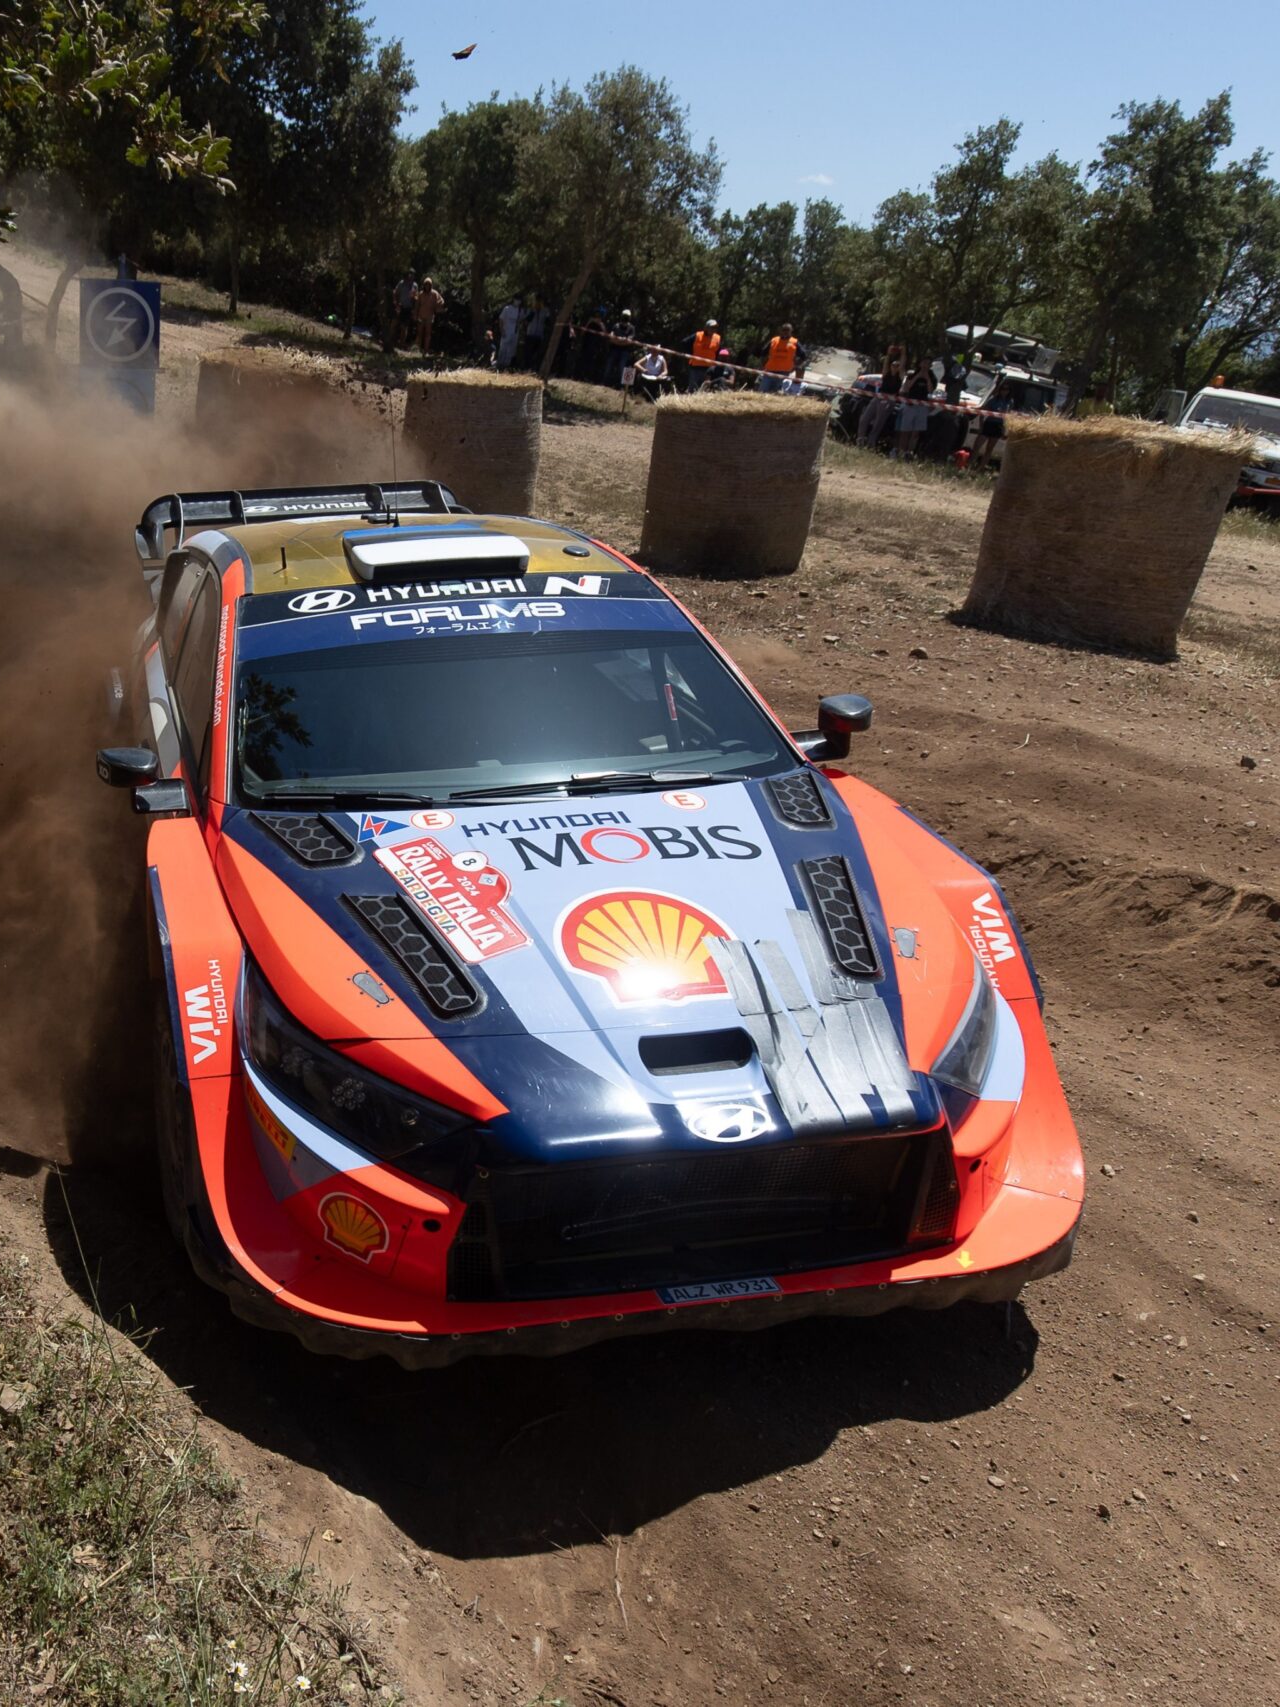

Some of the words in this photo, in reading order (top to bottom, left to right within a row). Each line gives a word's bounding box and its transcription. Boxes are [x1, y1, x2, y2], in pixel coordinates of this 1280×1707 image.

[283, 500, 369, 512] HYUNDA
[367, 578, 527, 603] HYUNDAI
[351, 602, 566, 630] FORUM8
[412, 620, 516, 635] フォーラムエイト
[213, 605, 230, 727] motorsport.hyundai.com
[673, 794, 696, 806] E
[422, 813, 443, 827] E
[461, 810, 631, 838] HYUNDAI
[505, 824, 763, 871] MOBIS
[462, 858, 477, 866] 8
[394, 846, 453, 891] RALLY
[437, 891, 505, 950] ITALIA
[456, 876, 481, 897] 2024
[394, 868, 458, 935] SARDEGNA
[208, 959, 228, 1024] HYUNDAI
[673, 1285, 711, 1301] ALZ
[711, 1283, 738, 1297] WR
[739, 1278, 777, 1293] 931
